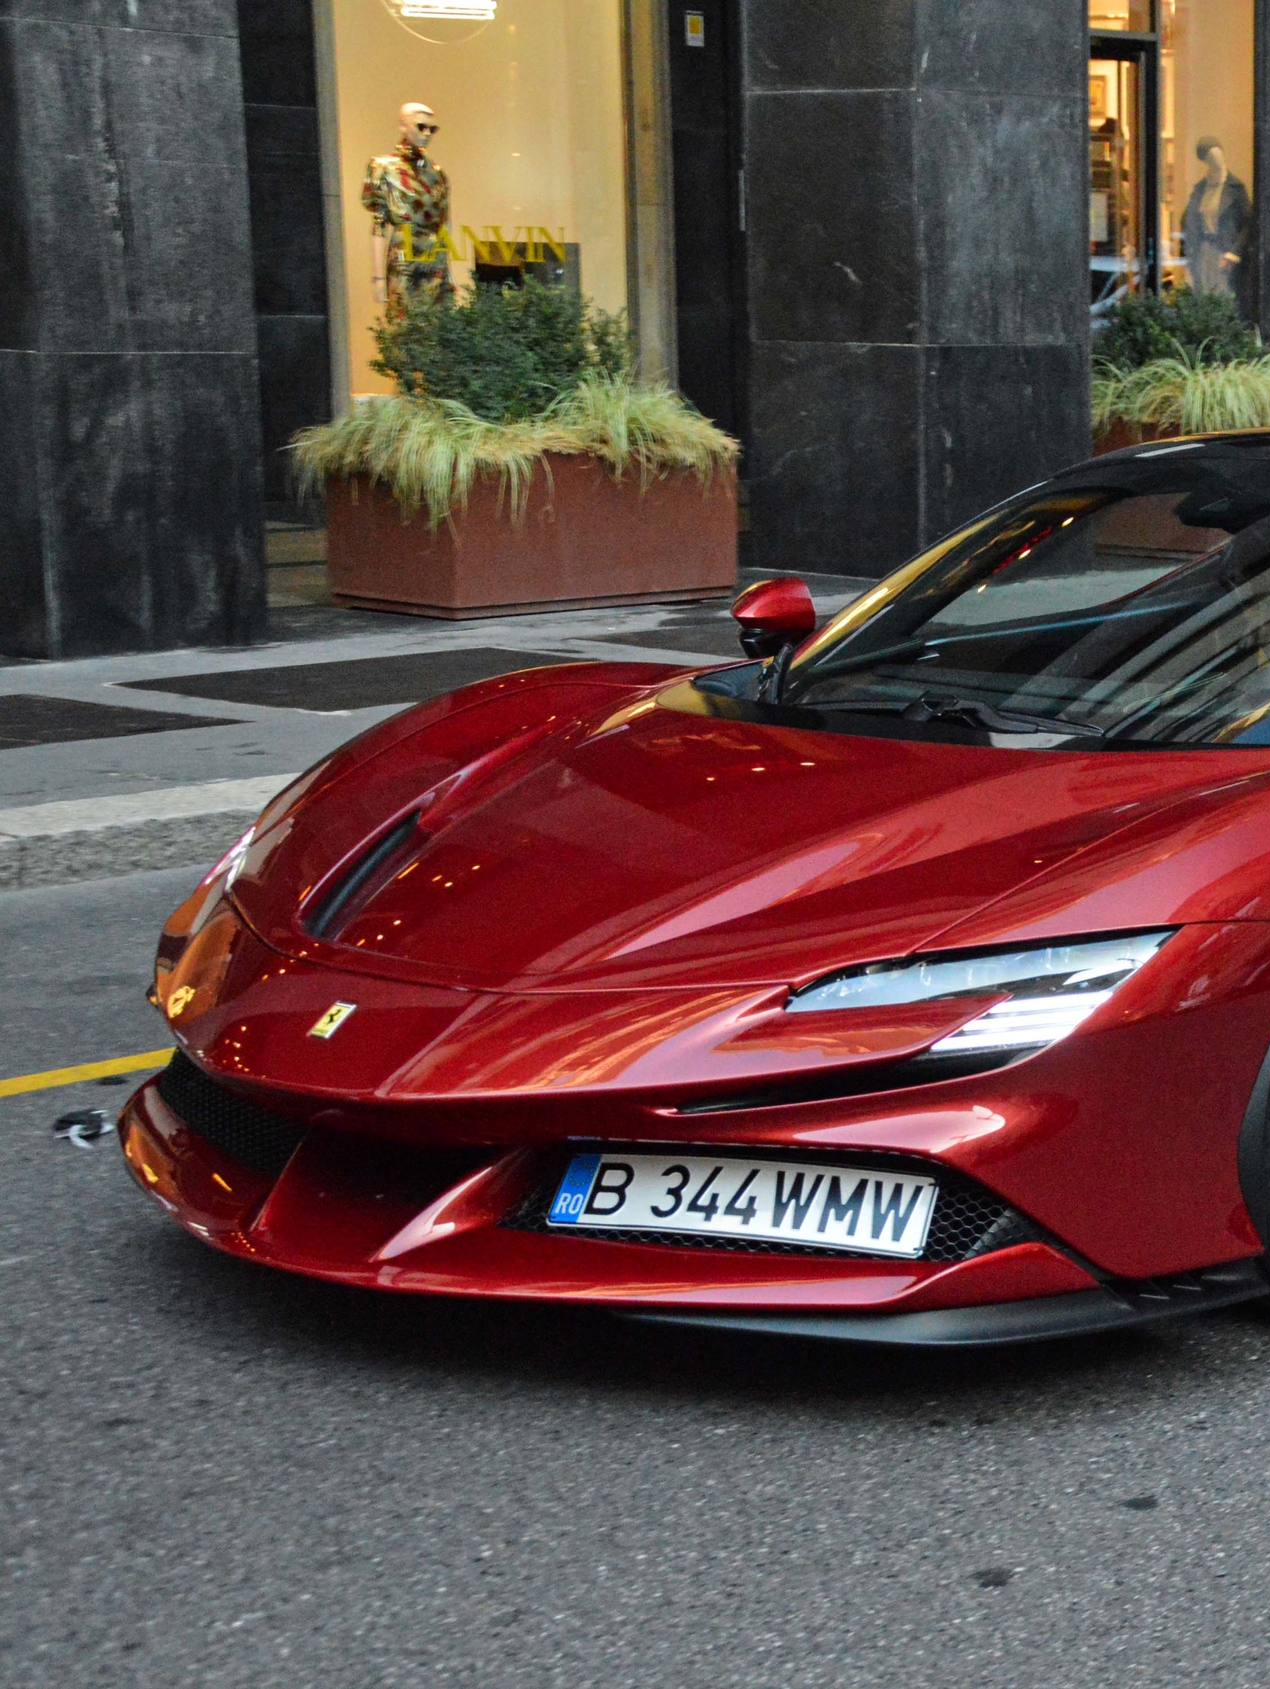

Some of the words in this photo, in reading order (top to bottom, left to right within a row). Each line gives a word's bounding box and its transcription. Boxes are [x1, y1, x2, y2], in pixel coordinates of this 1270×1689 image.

[401, 223, 567, 264] LANVIN
[554, 1192, 584, 1215] RO
[583, 1162, 635, 1216] B
